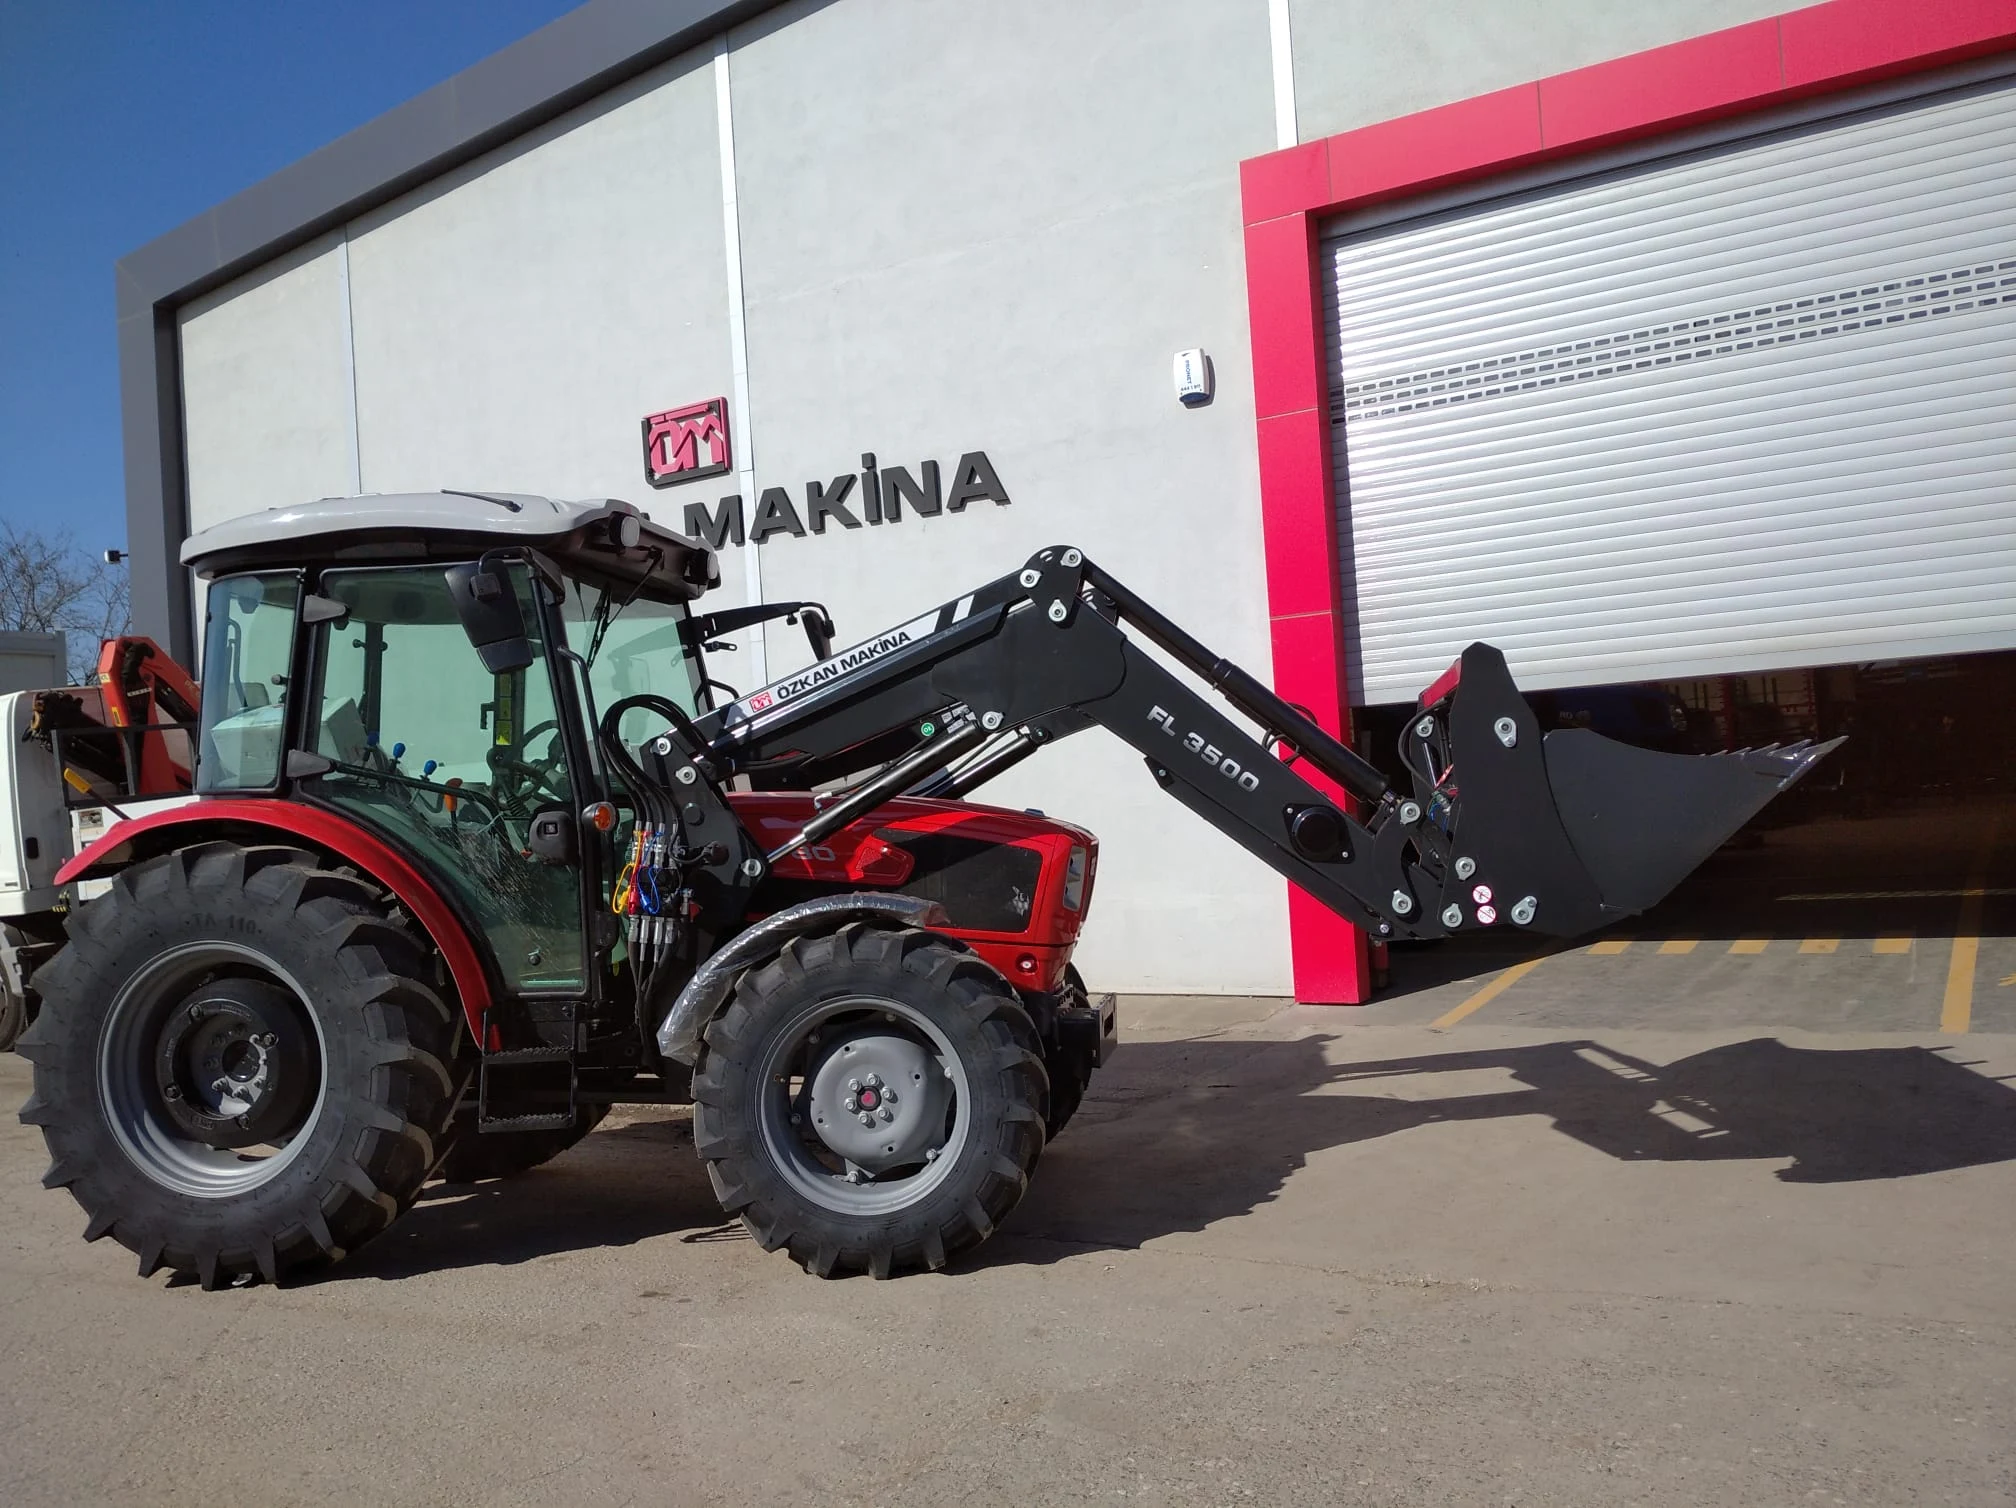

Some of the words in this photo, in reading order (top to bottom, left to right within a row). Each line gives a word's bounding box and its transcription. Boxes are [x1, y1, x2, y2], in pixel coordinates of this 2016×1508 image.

[683, 451, 1012, 550] MAKİNA
[777, 663, 839, 700] ÖZKAN
[841, 631, 912, 671] MAKİNA
[1146, 704, 1176, 737] FL
[1182, 731, 1260, 792] 3500
